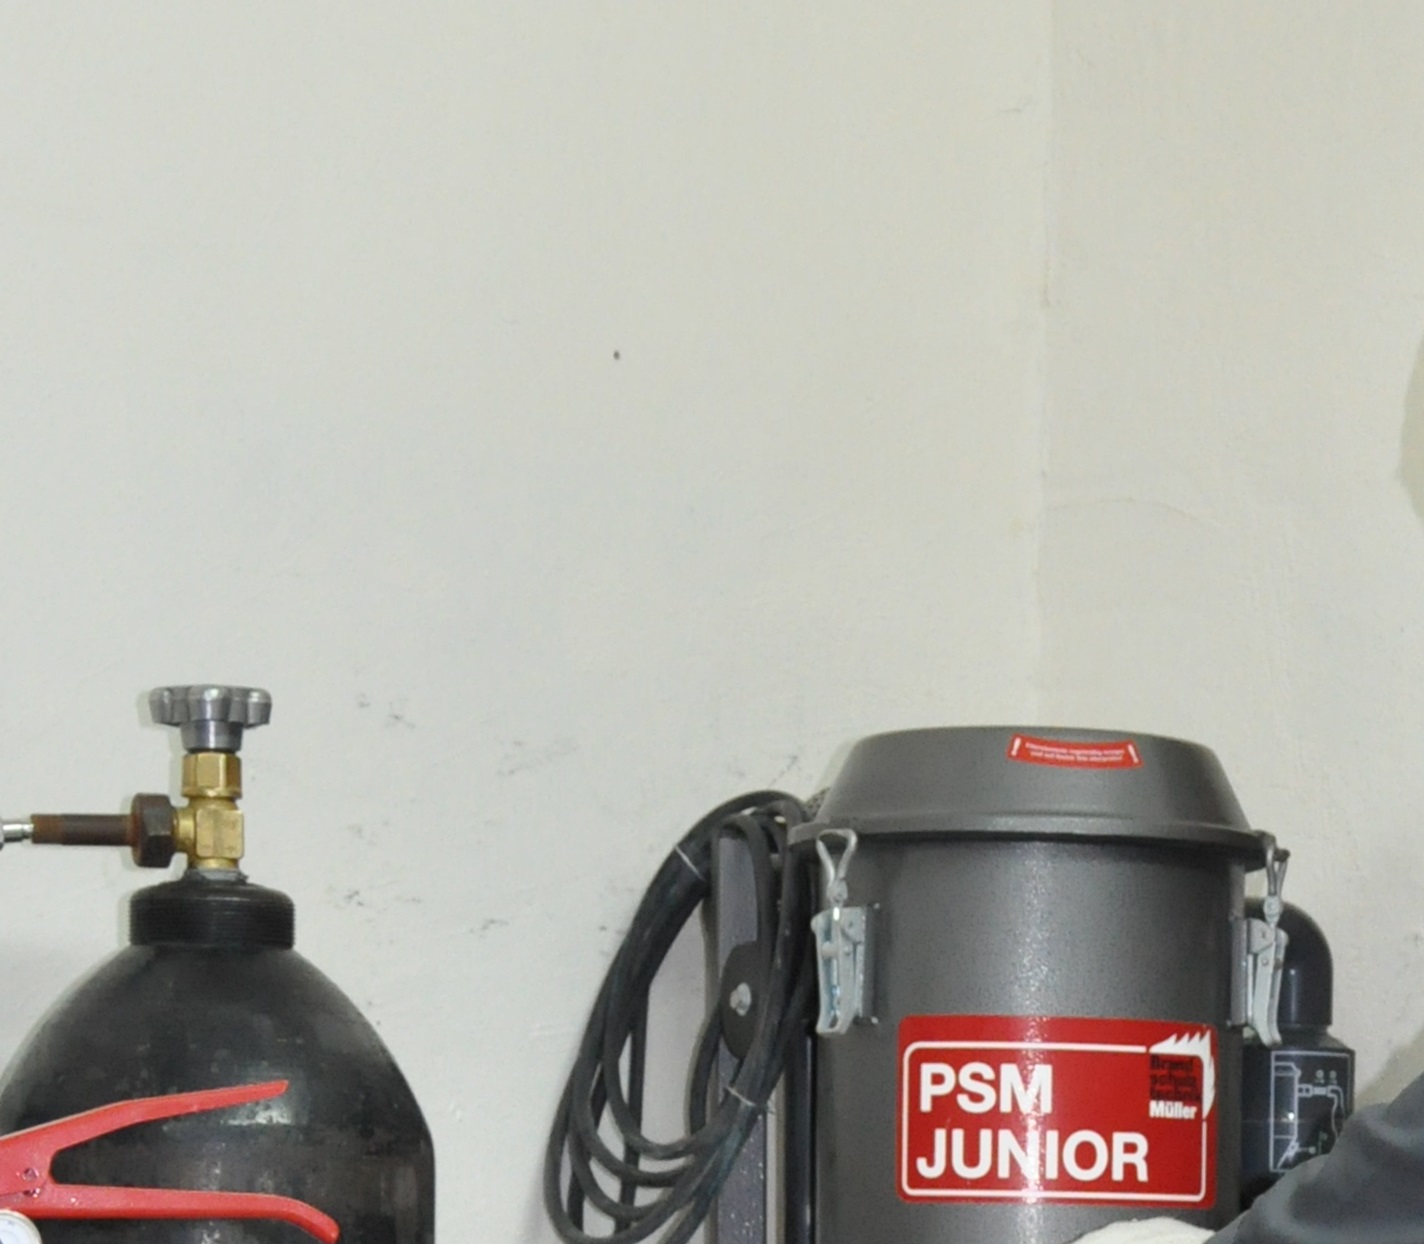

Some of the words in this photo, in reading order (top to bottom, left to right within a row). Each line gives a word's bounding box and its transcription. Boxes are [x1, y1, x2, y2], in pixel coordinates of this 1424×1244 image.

[920, 1062, 1052, 1113] PSM
[1149, 1100, 1198, 1119] Müller
[916, 1128, 1149, 1182] JUNIOR
